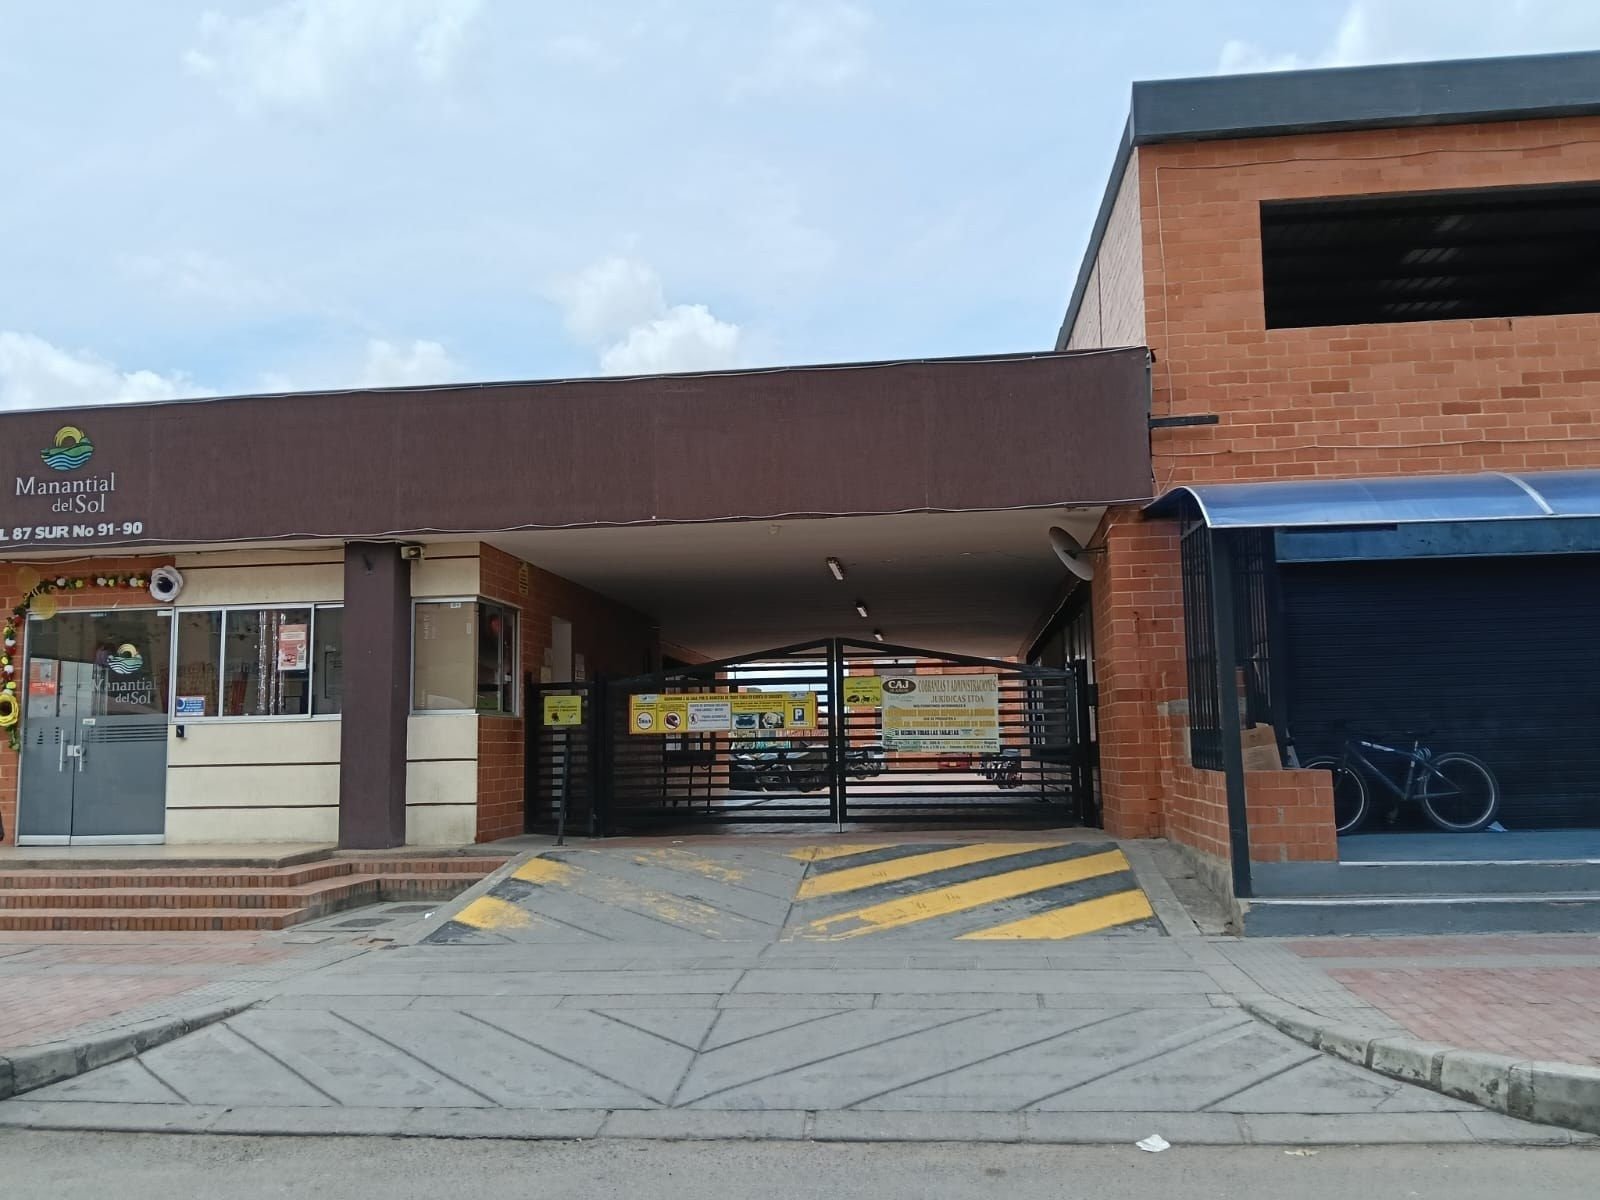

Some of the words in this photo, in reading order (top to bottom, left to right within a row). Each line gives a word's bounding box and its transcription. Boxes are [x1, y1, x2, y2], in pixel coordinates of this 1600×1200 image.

[15, 472, 115, 495] Manantial
[52, 498, 73, 512] del
[75, 493, 105, 514] Sol
[12, 527, 32, 541] 87
[35, 525, 69, 539] SUR
[73, 524, 94, 537] No
[97, 521, 143, 536] 91-90
[888, 680, 909, 689] CAJ
[115, 693, 130, 703] del
[130, 690, 151, 705] Sol
